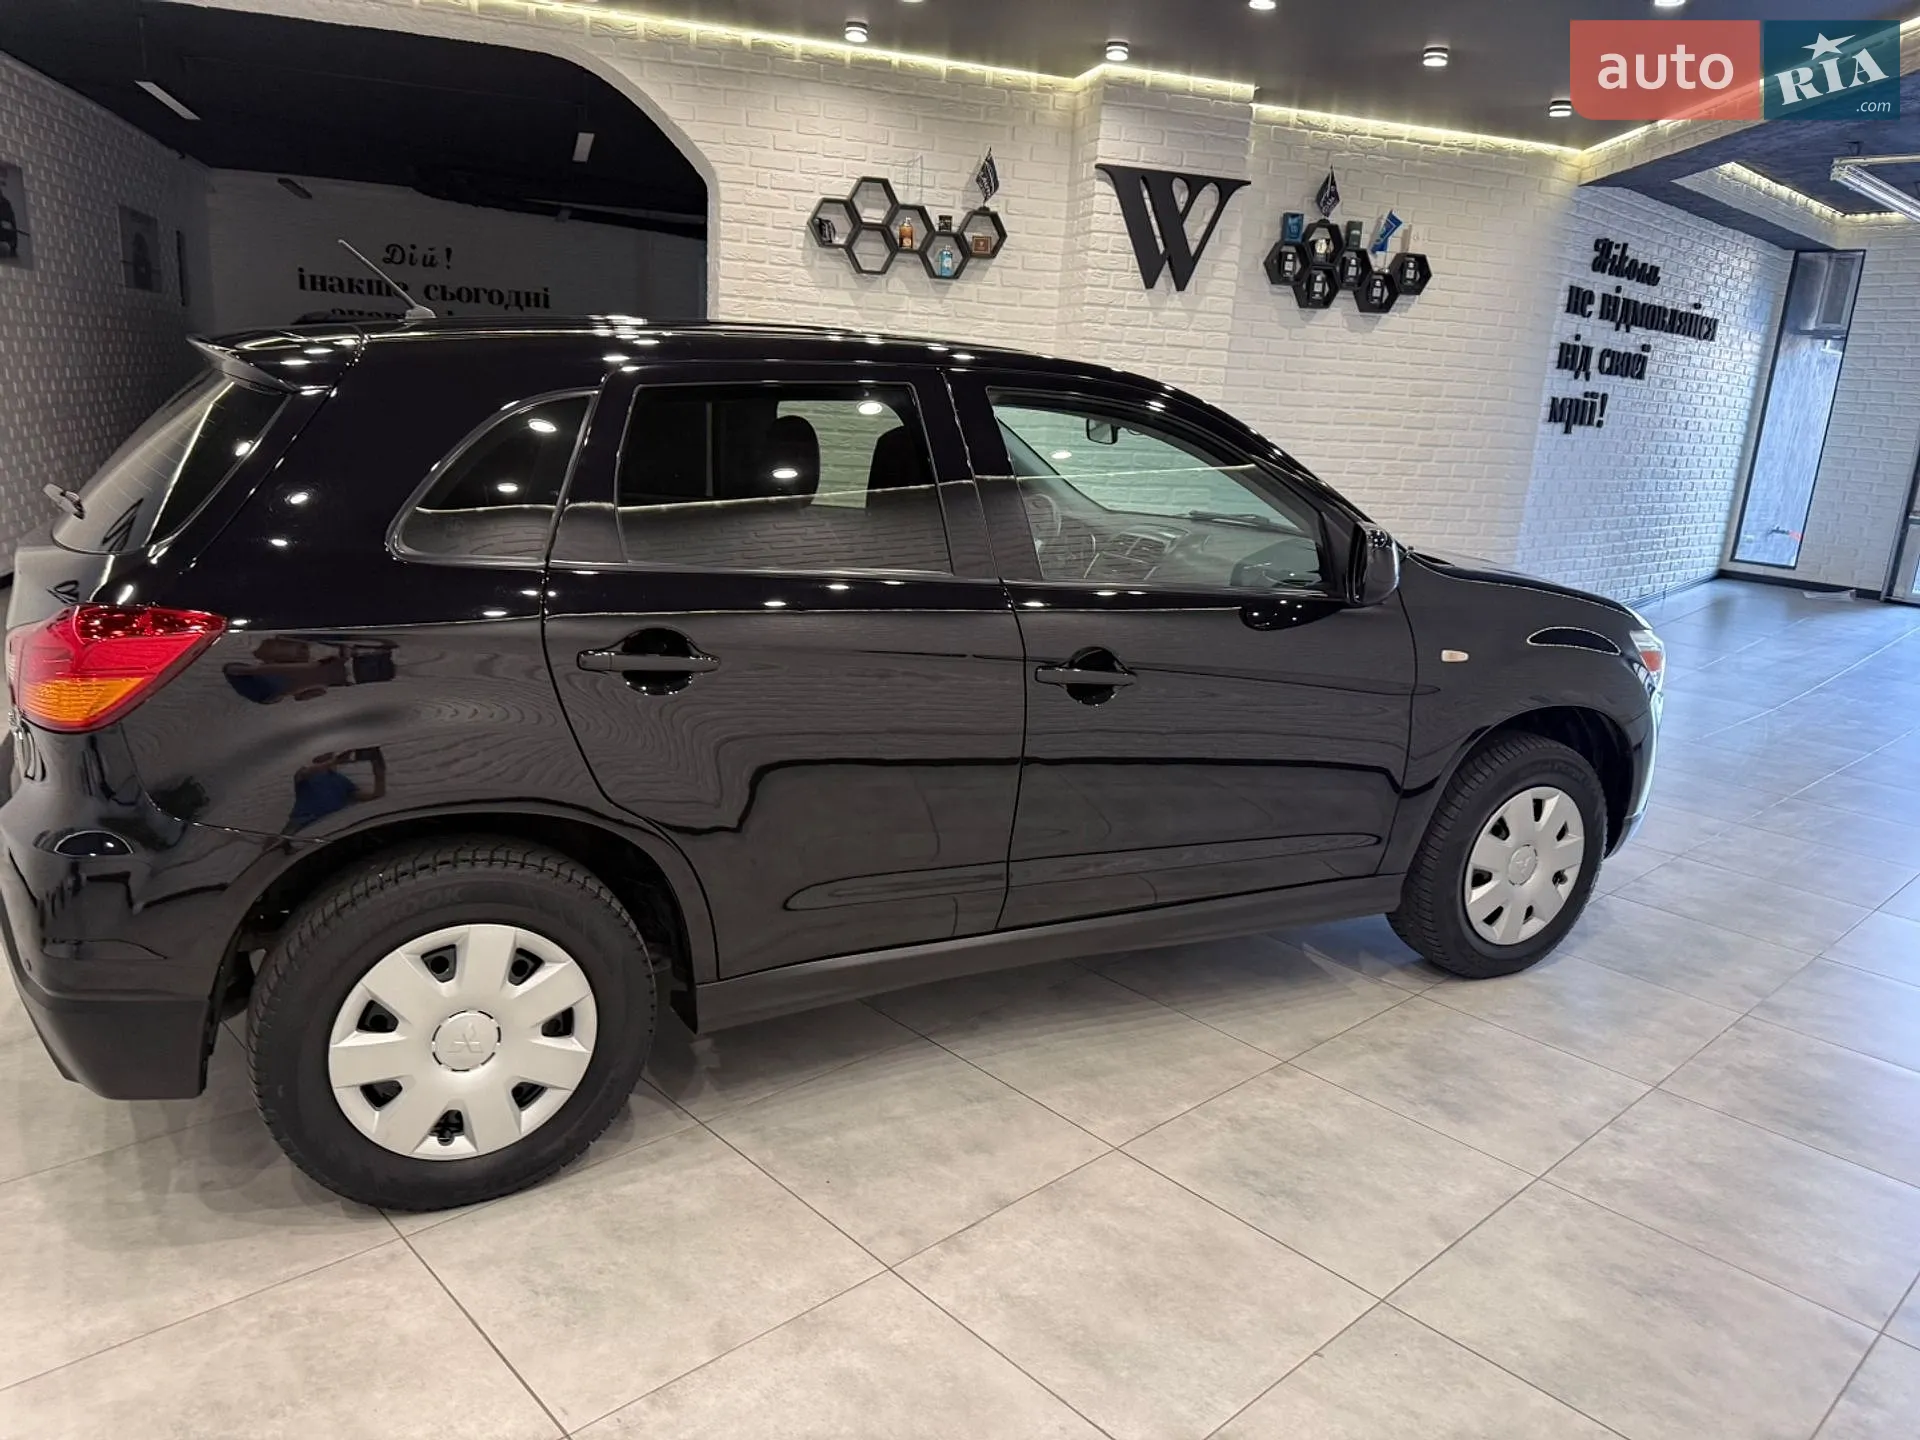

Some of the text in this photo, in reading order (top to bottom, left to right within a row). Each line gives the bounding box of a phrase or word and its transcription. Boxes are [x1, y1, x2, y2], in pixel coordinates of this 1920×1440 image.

[1095, 163, 1251, 292] W
[1592, 238, 1660, 286] Ніколи
[423, 284, 552, 311] сьогодні
[1565, 285, 1595, 318] не
[1556, 334, 1594, 382] від
[1548, 391, 1609, 434] мрії!
